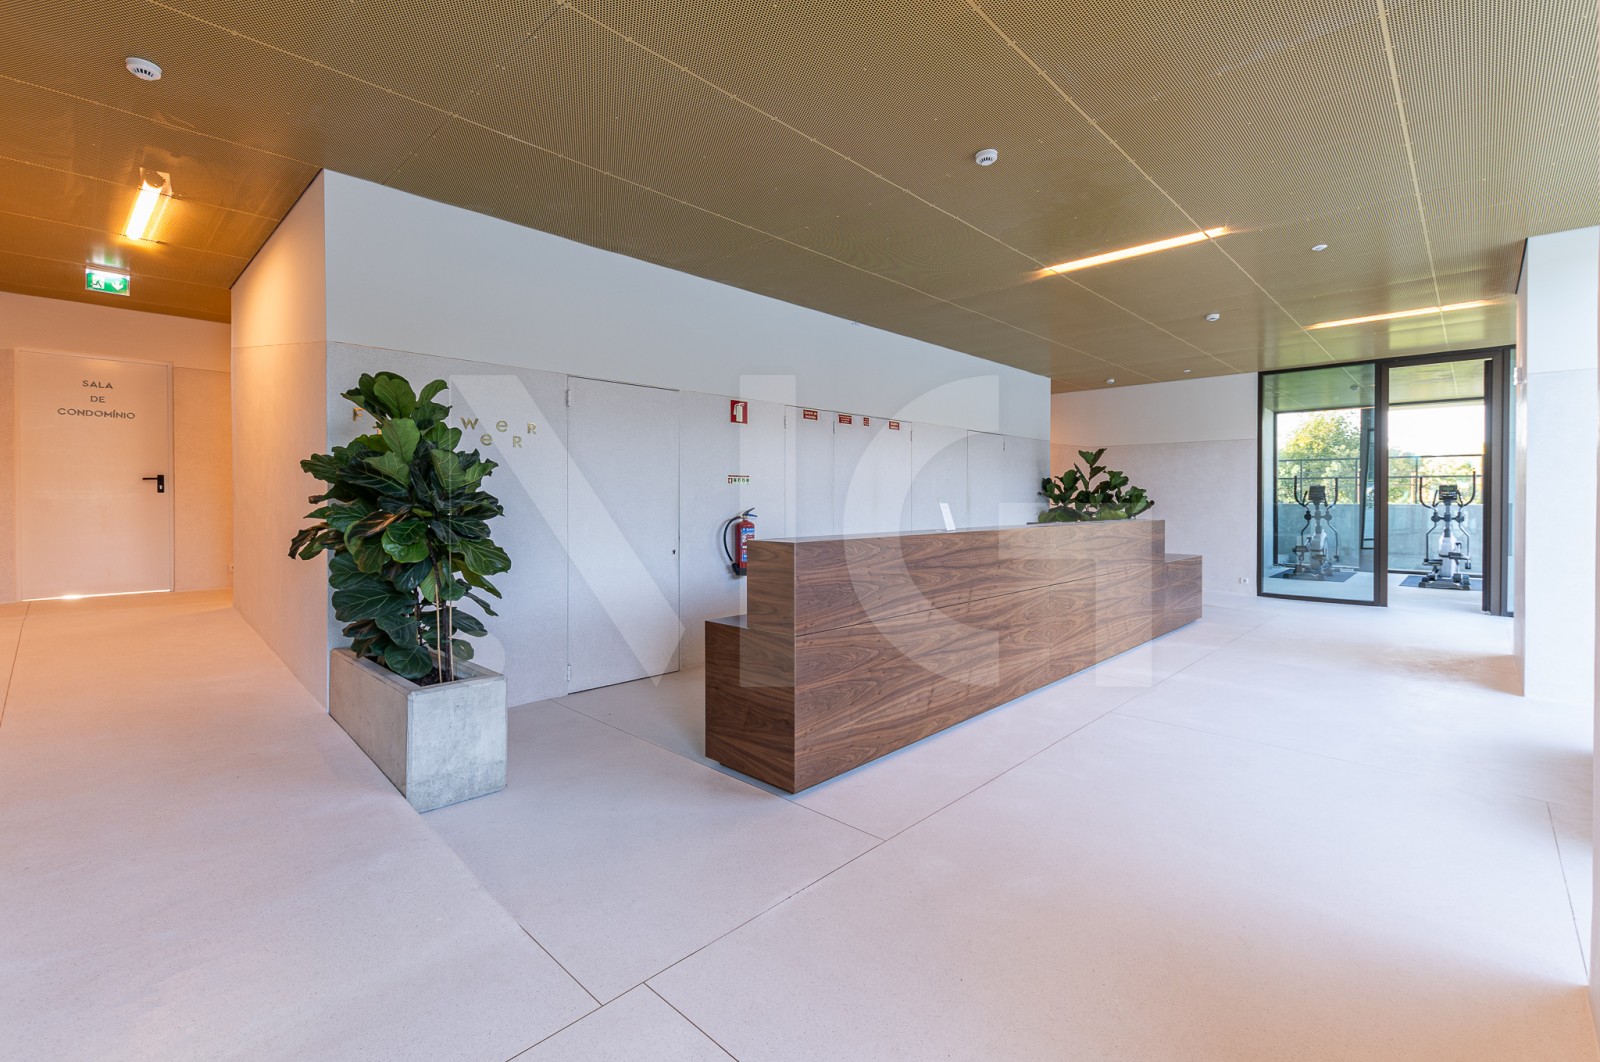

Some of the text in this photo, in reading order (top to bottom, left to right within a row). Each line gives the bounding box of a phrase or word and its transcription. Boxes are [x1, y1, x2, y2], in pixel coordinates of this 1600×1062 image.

[82, 379, 114, 390] SALA
[90, 395, 106, 403] DE
[57, 407, 136, 420] CONDOMÍNIO
